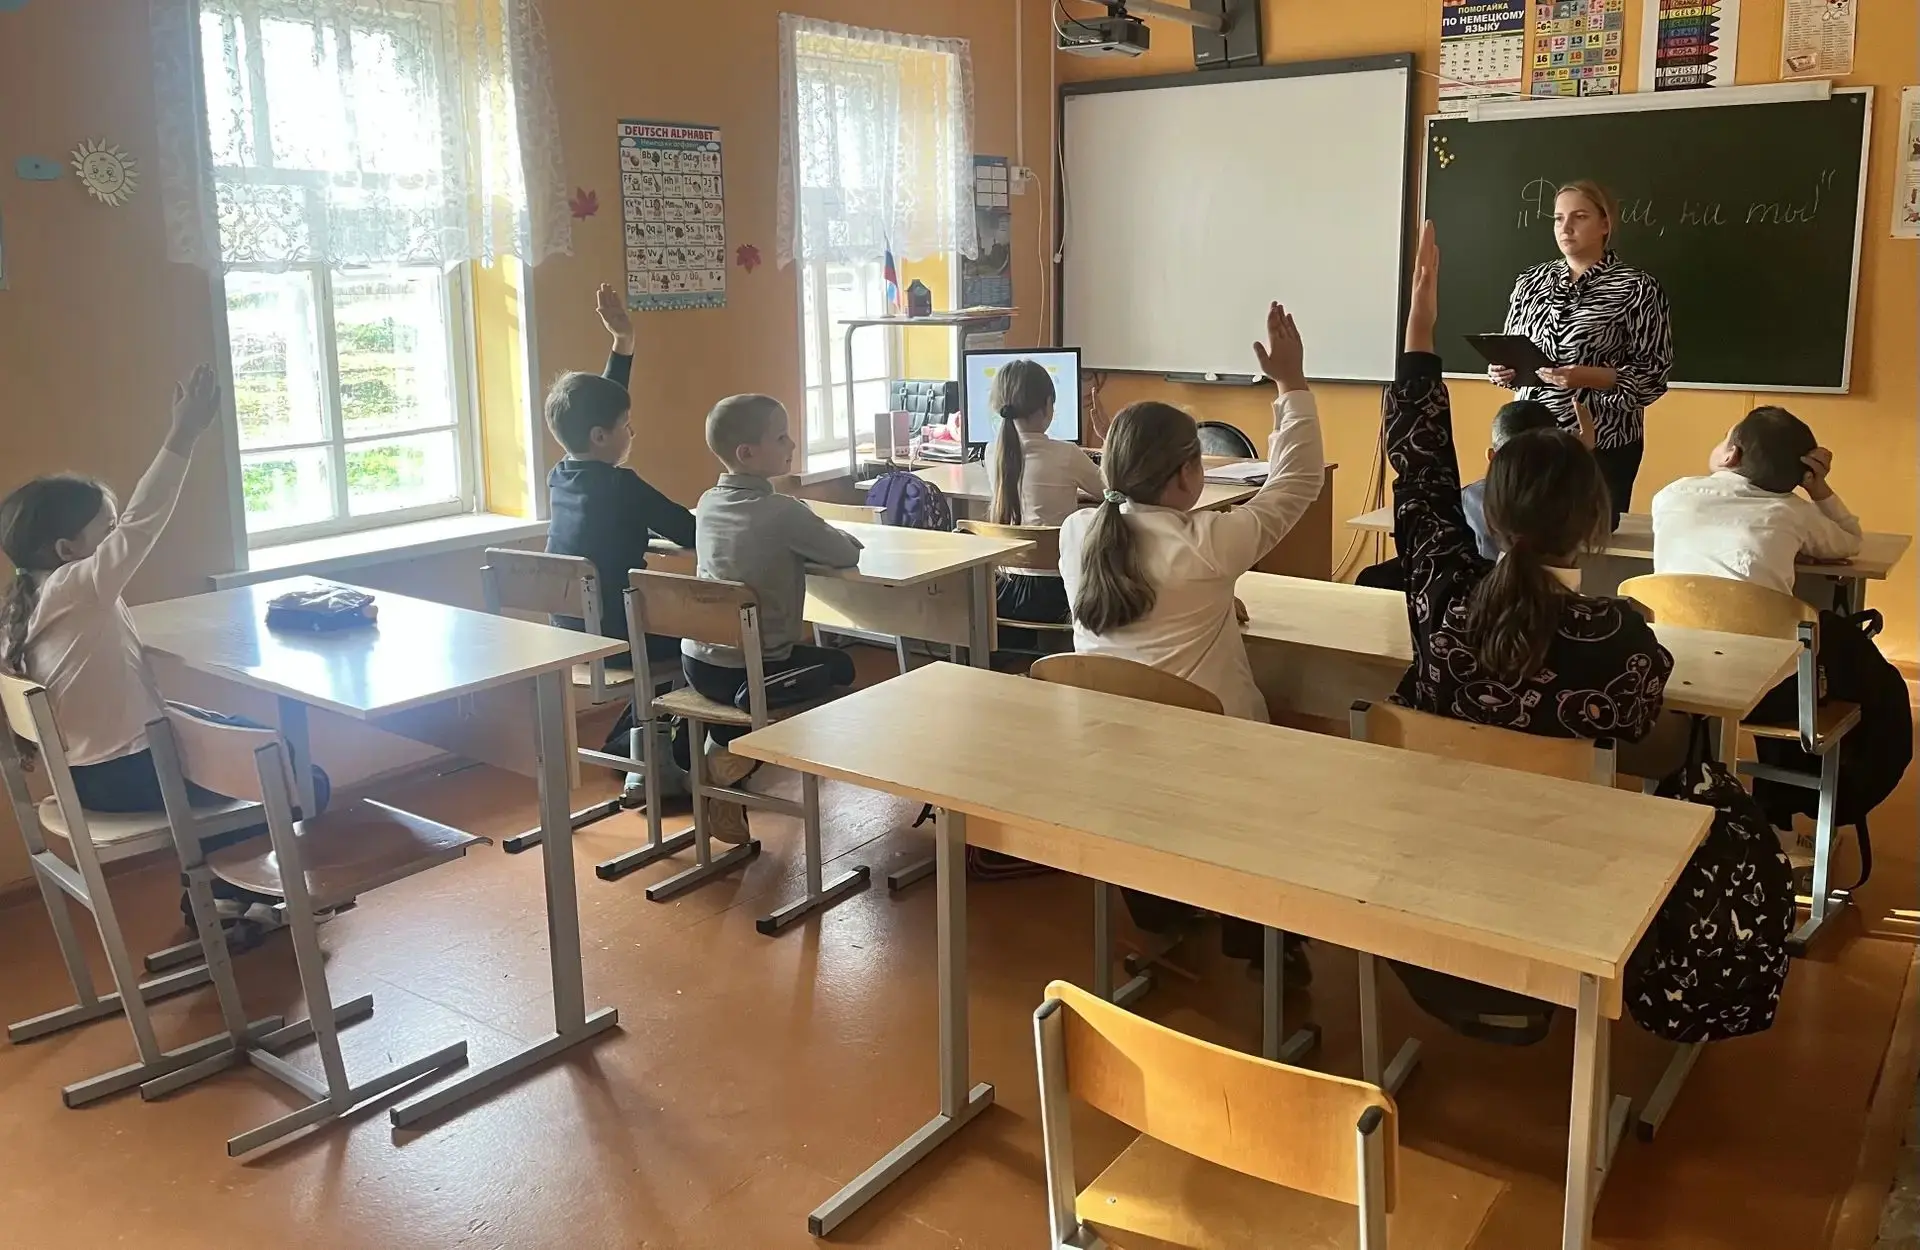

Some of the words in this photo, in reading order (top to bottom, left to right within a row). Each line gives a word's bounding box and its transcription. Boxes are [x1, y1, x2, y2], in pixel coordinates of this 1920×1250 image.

[1459, 3, 1509, 14] ПОМОГАЙКА
[1443, 18, 1457, 26] ПО
[1460, 10, 1524, 25] НЕМЕЦКОМУ
[1464, 22, 1500, 33] ЯЗЫКУ
[1554, 38, 1565, 46] 12
[1571, 36, 1583, 44] 13
[1588, 34, 1600, 42] 14
[1606, 32, 1618, 41] 15
[1537, 55, 1547, 63] 16
[1553, 53, 1564, 61] 17
[1570, 51, 1582, 59] 18
[1604, 49, 1617, 57] 20
[1671, 66, 1694, 74] WEISS
[625, 126, 668, 138] DEUTSCH
[670, 128, 713, 140] ALPHABET
